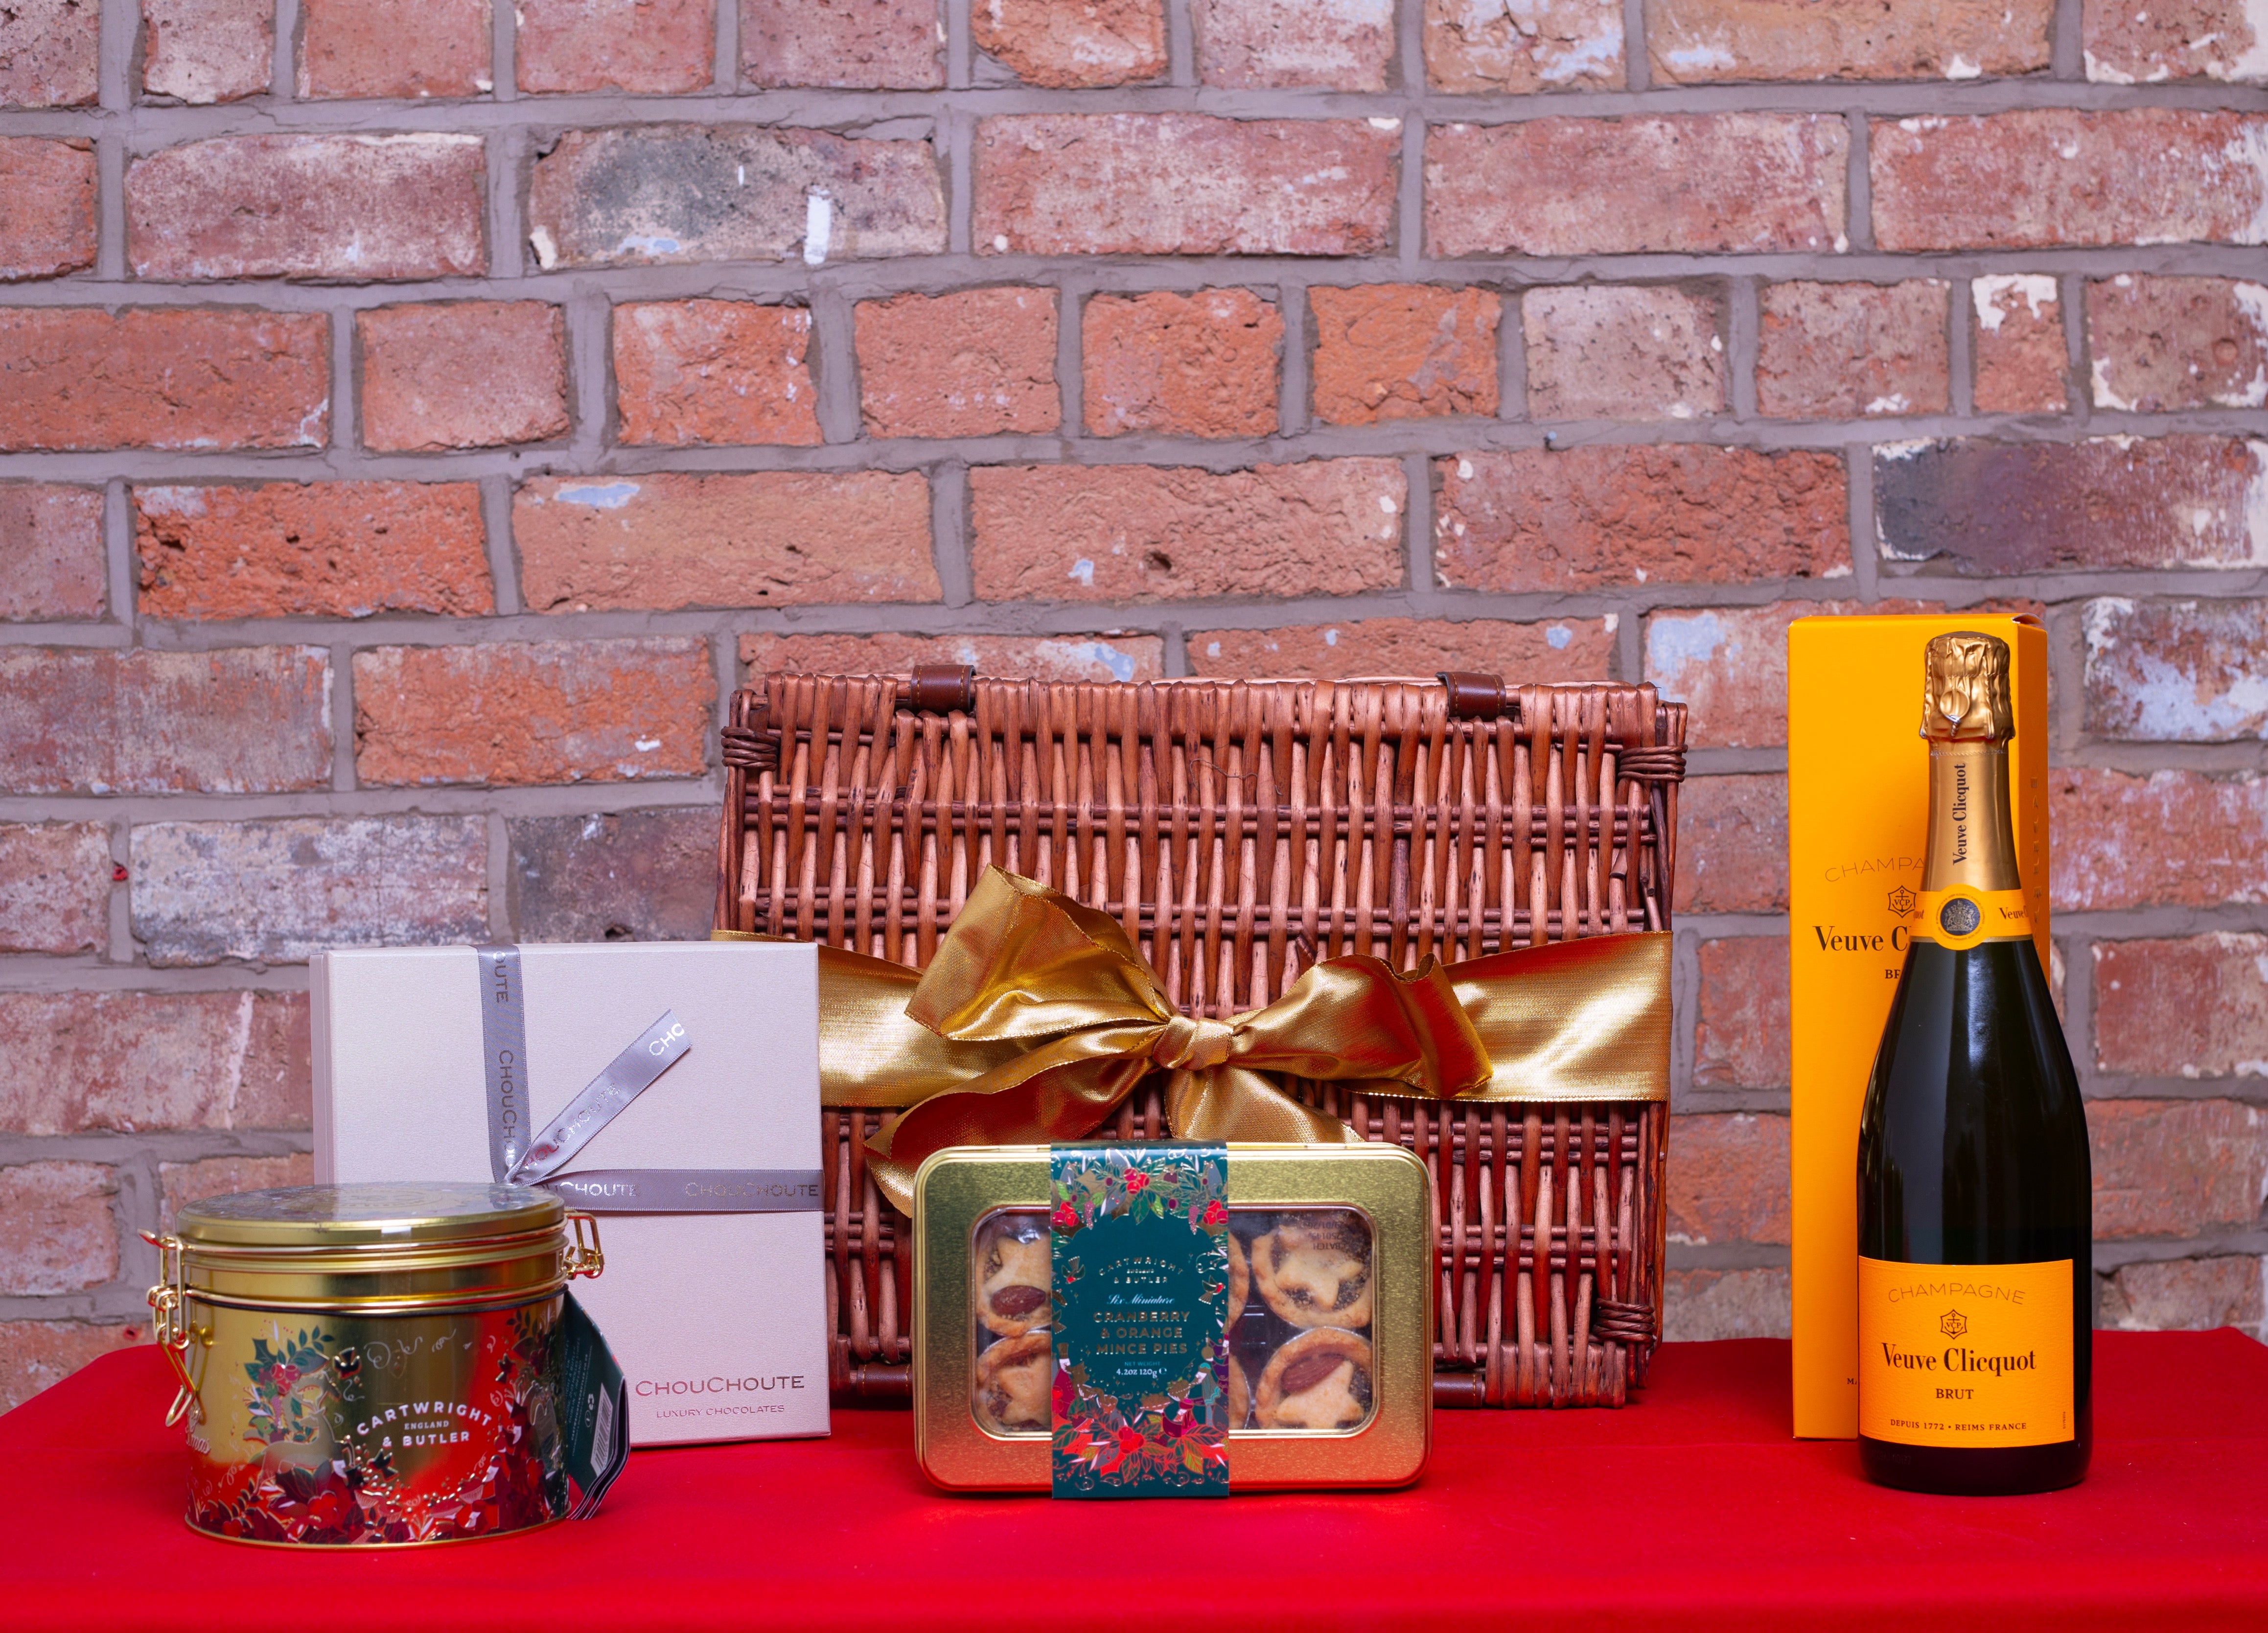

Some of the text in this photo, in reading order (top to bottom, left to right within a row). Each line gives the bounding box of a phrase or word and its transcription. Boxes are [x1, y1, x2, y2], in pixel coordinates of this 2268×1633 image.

[1952, 763, 1969, 865] Veuve Clicquot
[1812, 926, 1883, 951] Veuve
[685, 1181, 819, 1197] CHOUCHOUTE
[1099, 1257, 1183, 1276] CARTWRIGHT
[1107, 1293, 1175, 1305] Six Miniature
[1889, 1283, 2026, 1305] CHAMPAGNE
[1093, 1311, 1190, 1323] CRANBERRY
[1101, 1327, 1182, 1338] & ORANGE
[1096, 1343, 1187, 1354] MINCE PIES
[1881, 1343, 2037, 1376] Veuve Clicquot
[1139, 1369, 1157, 1378] 120g
[635, 1375, 805, 1396] CHOUCHOUTE
[1936, 1388, 1974, 1399] BRUT
[357, 1401, 491, 1435] CARTWRIGHT
[656, 1404, 785, 1418] LUXURY CHOCOLATES
[404, 1420, 449, 1430] ENGLAND
[1891, 1419, 1920, 1428] DEPUIS
[382, 1431, 469, 1447] & BUTLER
